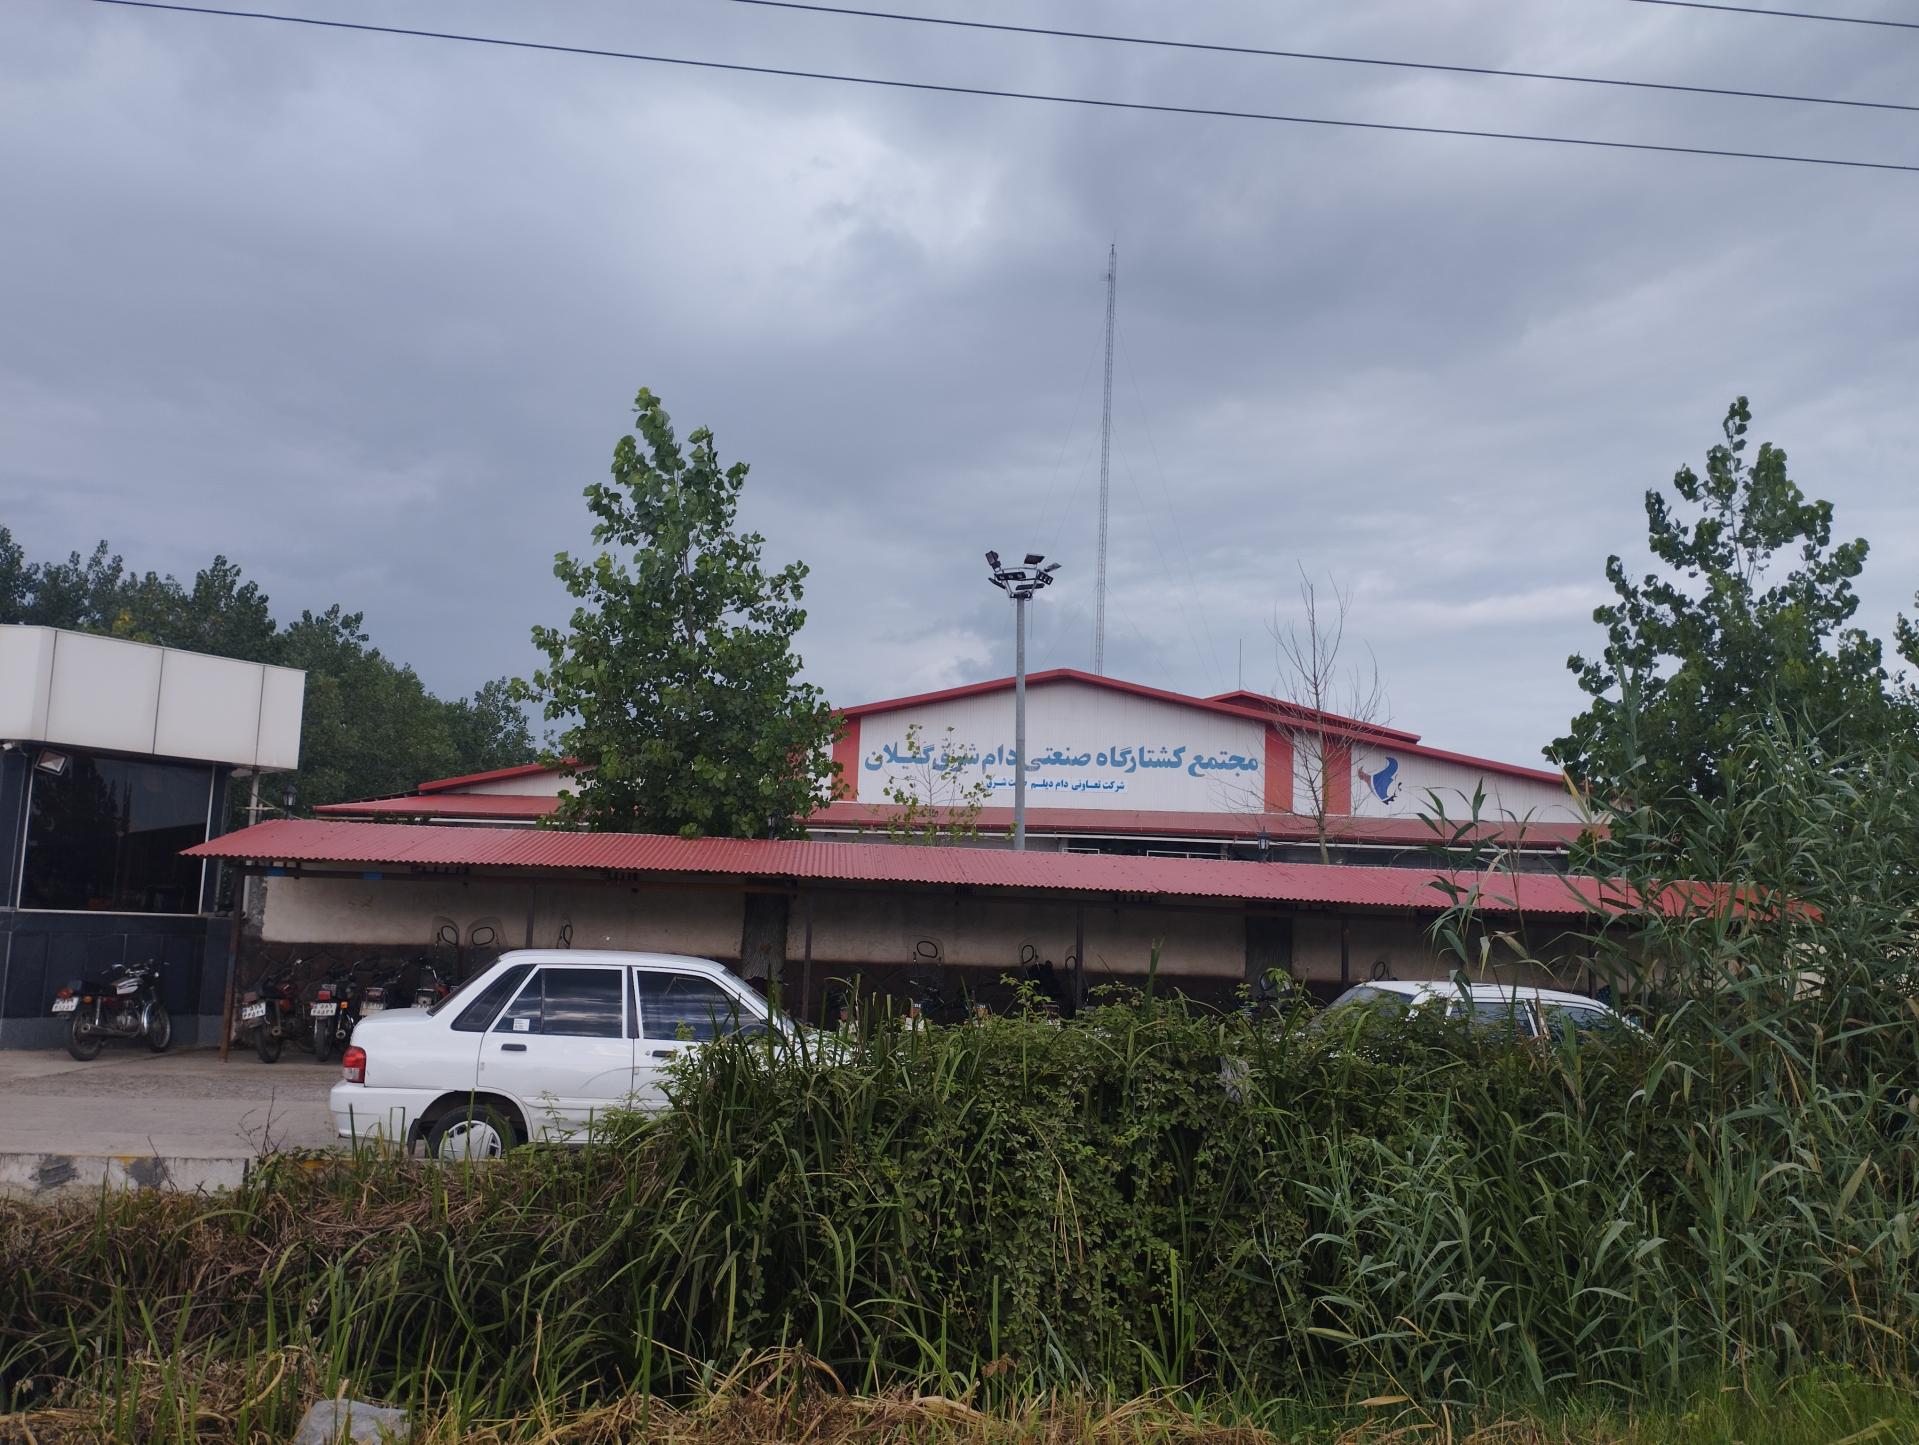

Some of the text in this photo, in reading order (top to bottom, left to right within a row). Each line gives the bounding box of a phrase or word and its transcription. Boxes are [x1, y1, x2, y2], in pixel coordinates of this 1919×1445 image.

[865, 741, 935, 772] گیلان
[981, 744, 1017, 774] دام
[1023, 746, 1092, 772] صنعتی
[1096, 745, 1186, 773] کشتارگاه
[1188, 750, 1259, 777] مجتمع
[1055, 779, 1069, 790] دام
[1071, 779, 1102, 792] تعاونی
[1102, 780, 1125, 793] شرکت
